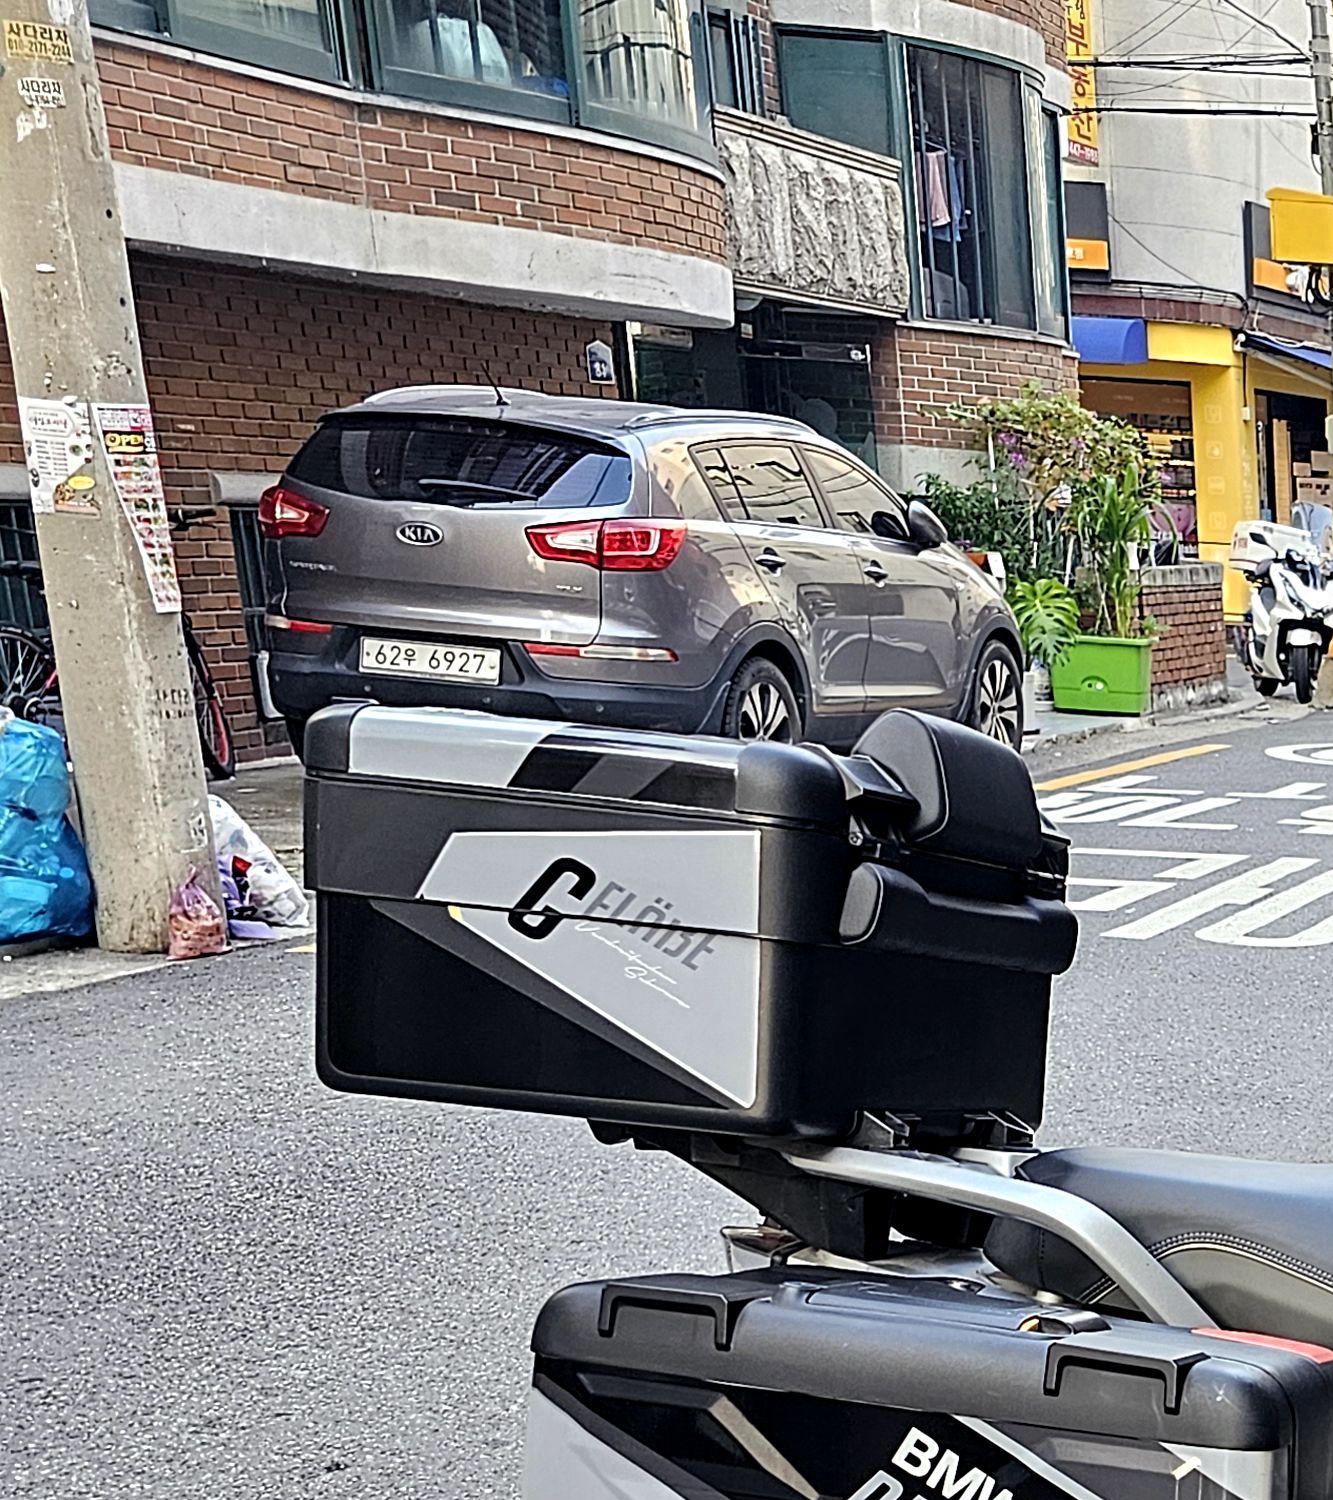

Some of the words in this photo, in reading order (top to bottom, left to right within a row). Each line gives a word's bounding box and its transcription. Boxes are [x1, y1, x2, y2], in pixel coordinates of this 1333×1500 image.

[404, 527, 434, 542] KIA
[375, 645, 416, 667] 62우
[428, 650, 486, 674] 6927
